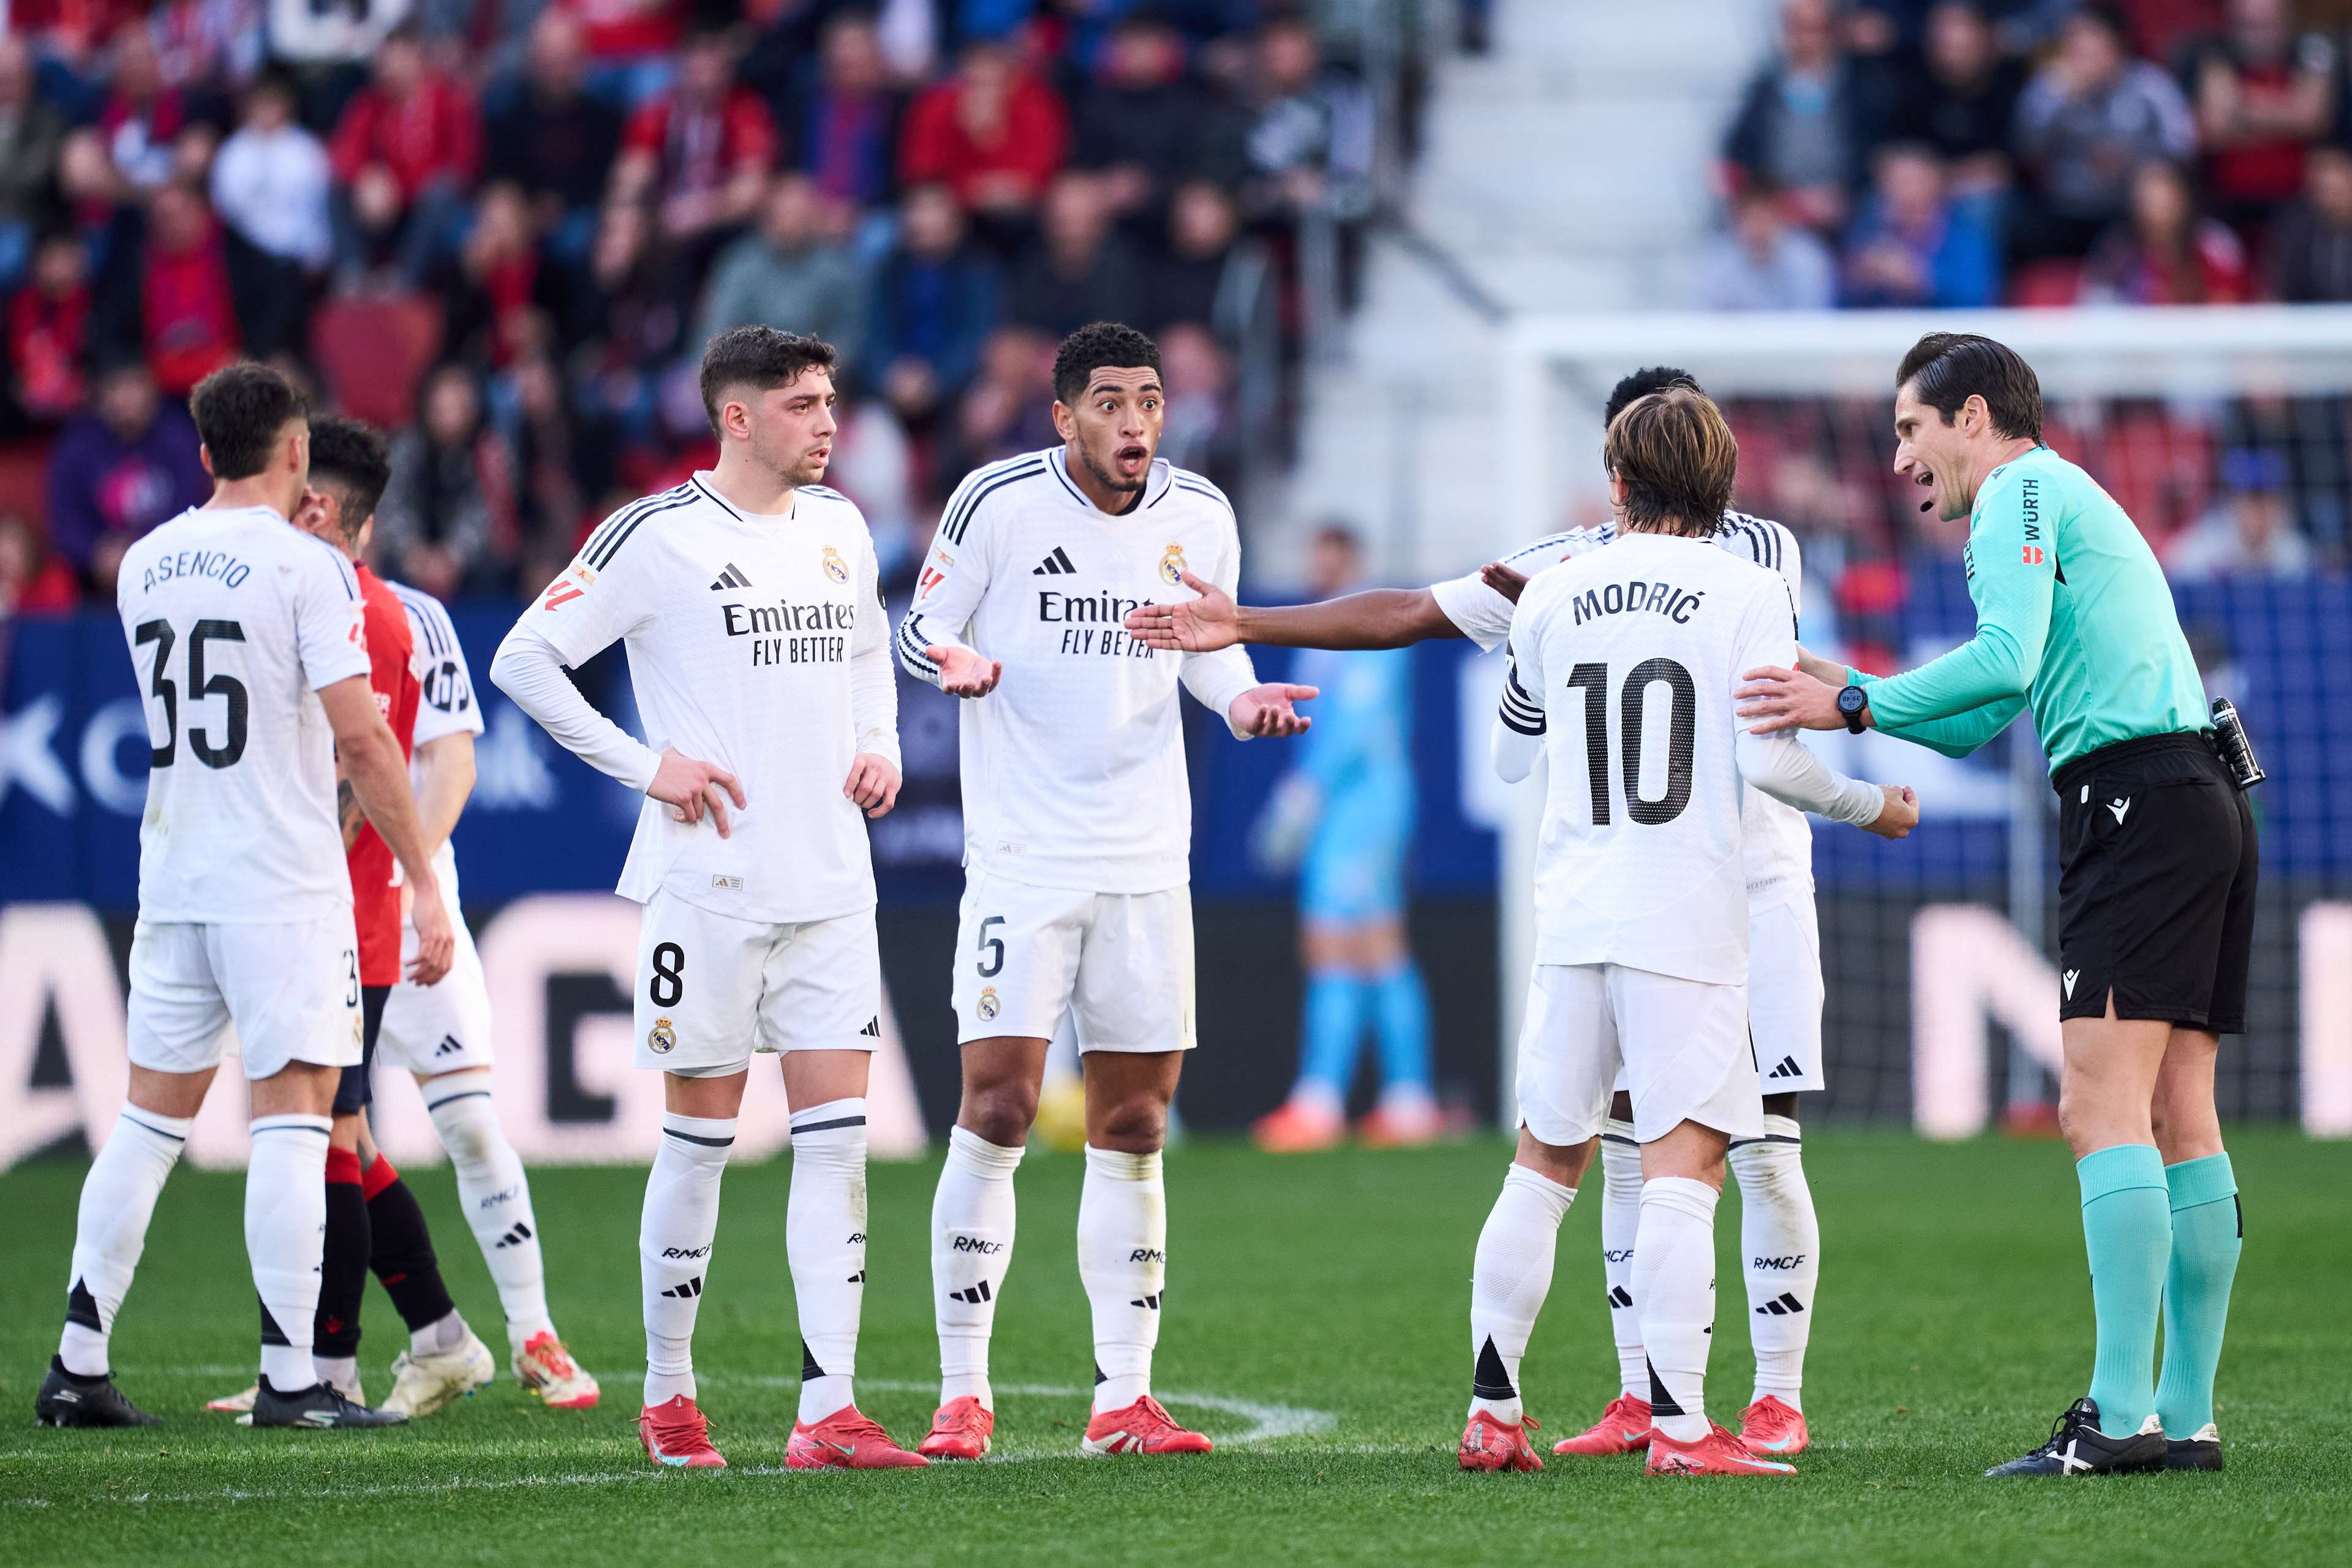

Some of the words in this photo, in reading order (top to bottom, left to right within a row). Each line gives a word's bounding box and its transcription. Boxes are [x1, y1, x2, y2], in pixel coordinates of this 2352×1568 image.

[2022, 479, 2040, 541] WÜRTH
[145, 551, 250, 594] ASENCIO
[721, 599, 854, 636] Emirates
[1573, 581, 1706, 626] MODRIĆ
[753, 639, 782, 666] FLY
[790, 636, 843, 663] BETTER
[1061, 630, 1094, 655] FLY
[135, 619, 249, 771] 35
[426, 662, 469, 712] hp
[1566, 657, 1696, 826] 10
[977, 916, 1006, 978] 5
[650, 941, 685, 1008] 8
[953, 1236, 1003, 1254] RMCF
[1129, 1249, 1166, 1263] RMC
[1754, 1255, 1806, 1270] RMCF
